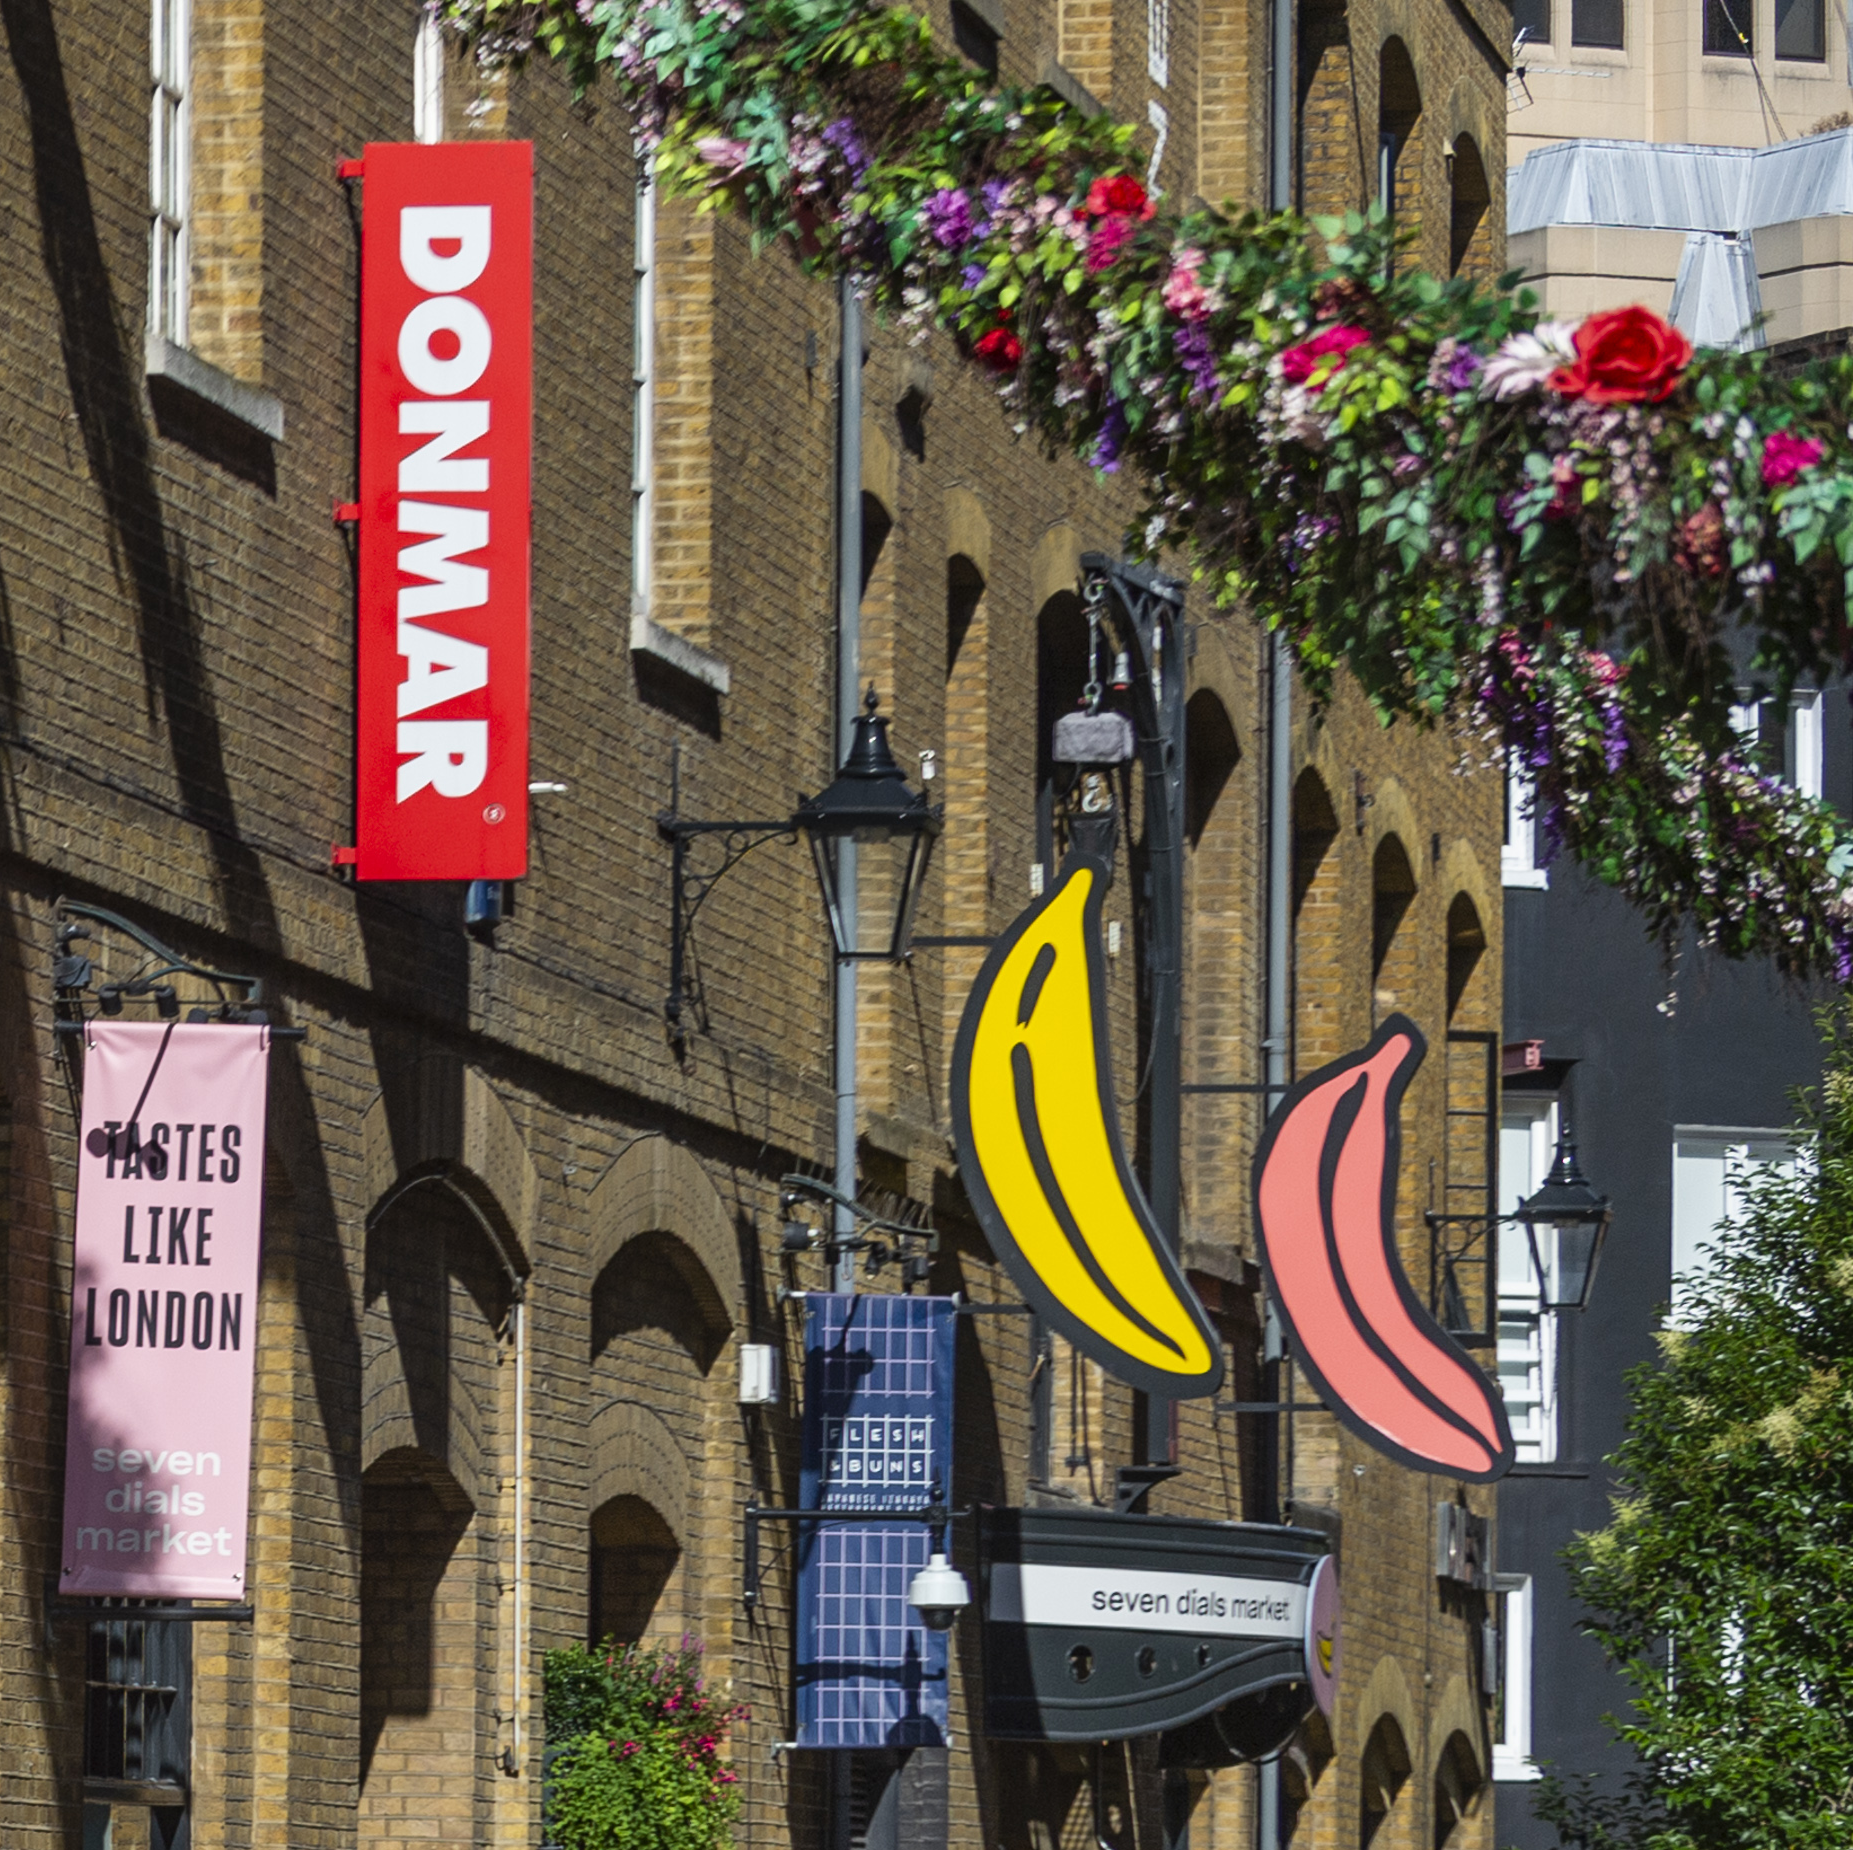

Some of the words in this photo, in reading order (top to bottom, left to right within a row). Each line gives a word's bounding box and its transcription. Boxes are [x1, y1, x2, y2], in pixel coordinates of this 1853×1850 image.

[397, 204, 492, 803] DONMAR
[103, 1121, 242, 1184] TASTES
[123, 1205, 212, 1266] LIKE
[84, 1288, 243, 1352] LONDON
[829, 1427, 925, 1442] FLESH
[93, 1448, 220, 1478] seven
[105, 1482, 205, 1516] dials
[76, 1521, 231, 1557] market
[1091, 1589, 1170, 1614] seven
[1176, 1588, 1226, 1618] dials
[1231, 1595, 1291, 1622] market
